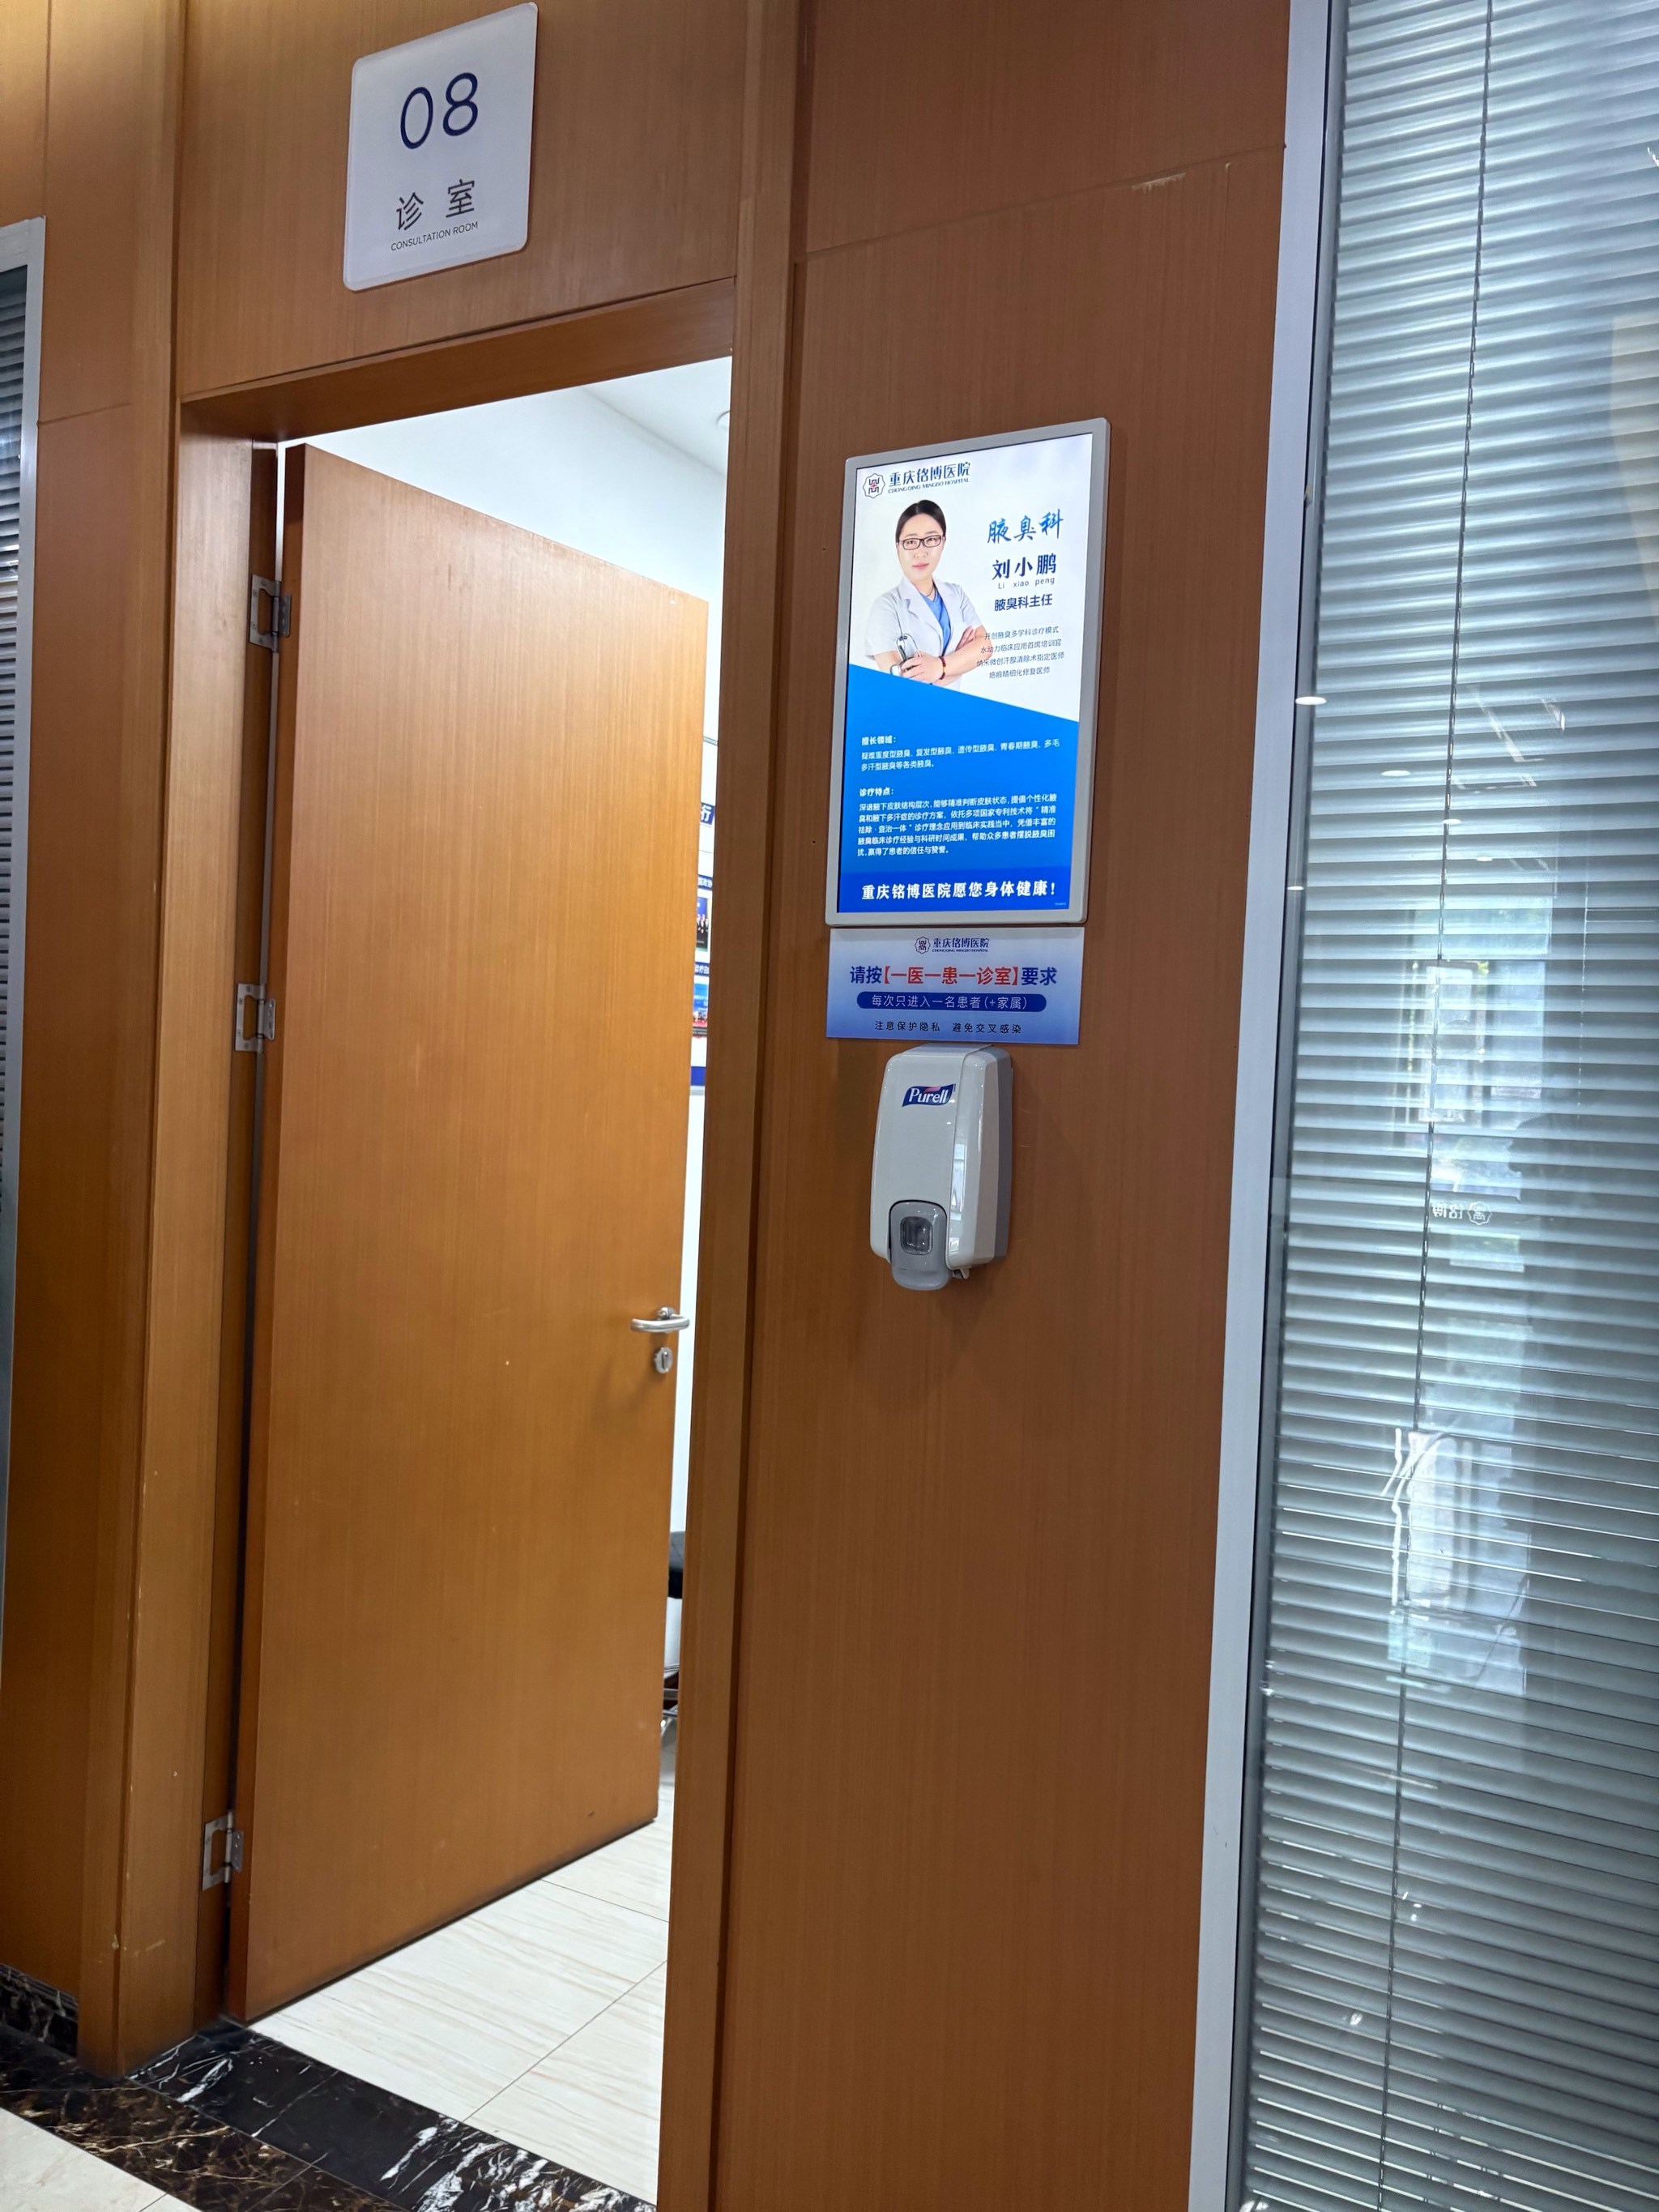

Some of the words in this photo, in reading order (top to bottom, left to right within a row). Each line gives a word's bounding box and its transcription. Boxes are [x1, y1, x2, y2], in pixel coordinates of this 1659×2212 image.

[400, 72, 479, 149] 08
[396, 179, 475, 230] 诊室
[390, 228, 451, 251] CONSULTATION
[453, 221, 479, 235] ROOM
[987, 509, 1064, 544] 腋臭科
[992, 553, 1056, 581] 刘小鹏
[998, 582, 1005, 590] Li
[1013, 579, 1030, 588] xiao
[1034, 576, 1055, 587] peng
[994, 593, 1053, 612] 腋臭科主任
[875, 1021, 940, 1031] 注意保护隐私
[952, 1023, 1022, 1034] 避免交叉感染
[909, 1087, 949, 1104] Purell
